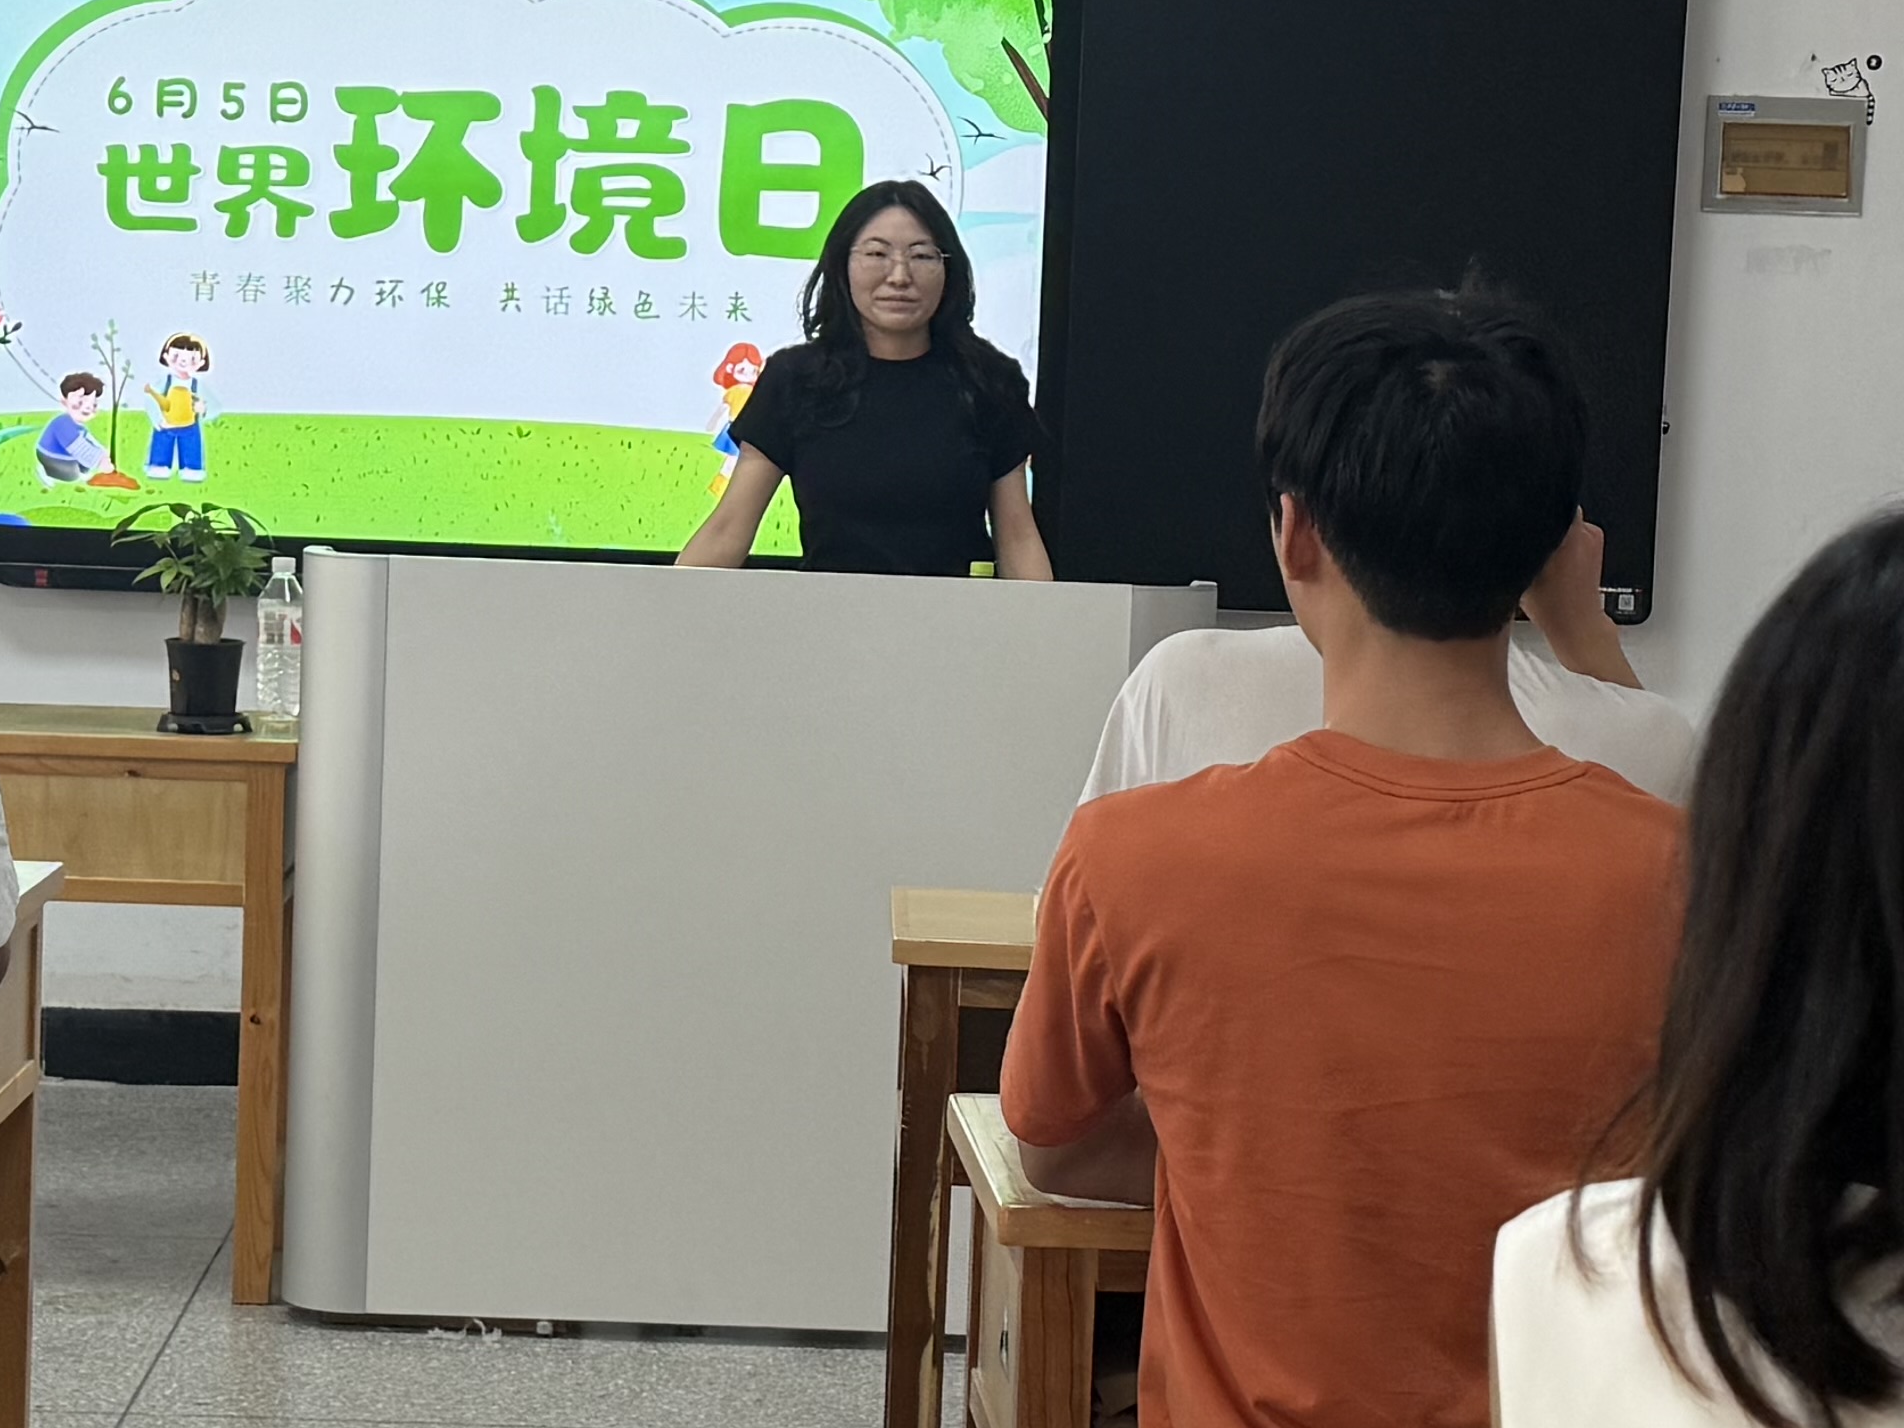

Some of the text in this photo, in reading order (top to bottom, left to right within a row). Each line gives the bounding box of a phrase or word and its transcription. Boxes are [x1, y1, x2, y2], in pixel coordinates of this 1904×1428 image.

[108, 76, 308, 124] 6月5日
[97, 85, 865, 262] 世界 环境日
[189, 271, 753, 323] 青春聚力环保 共话绿色未来
